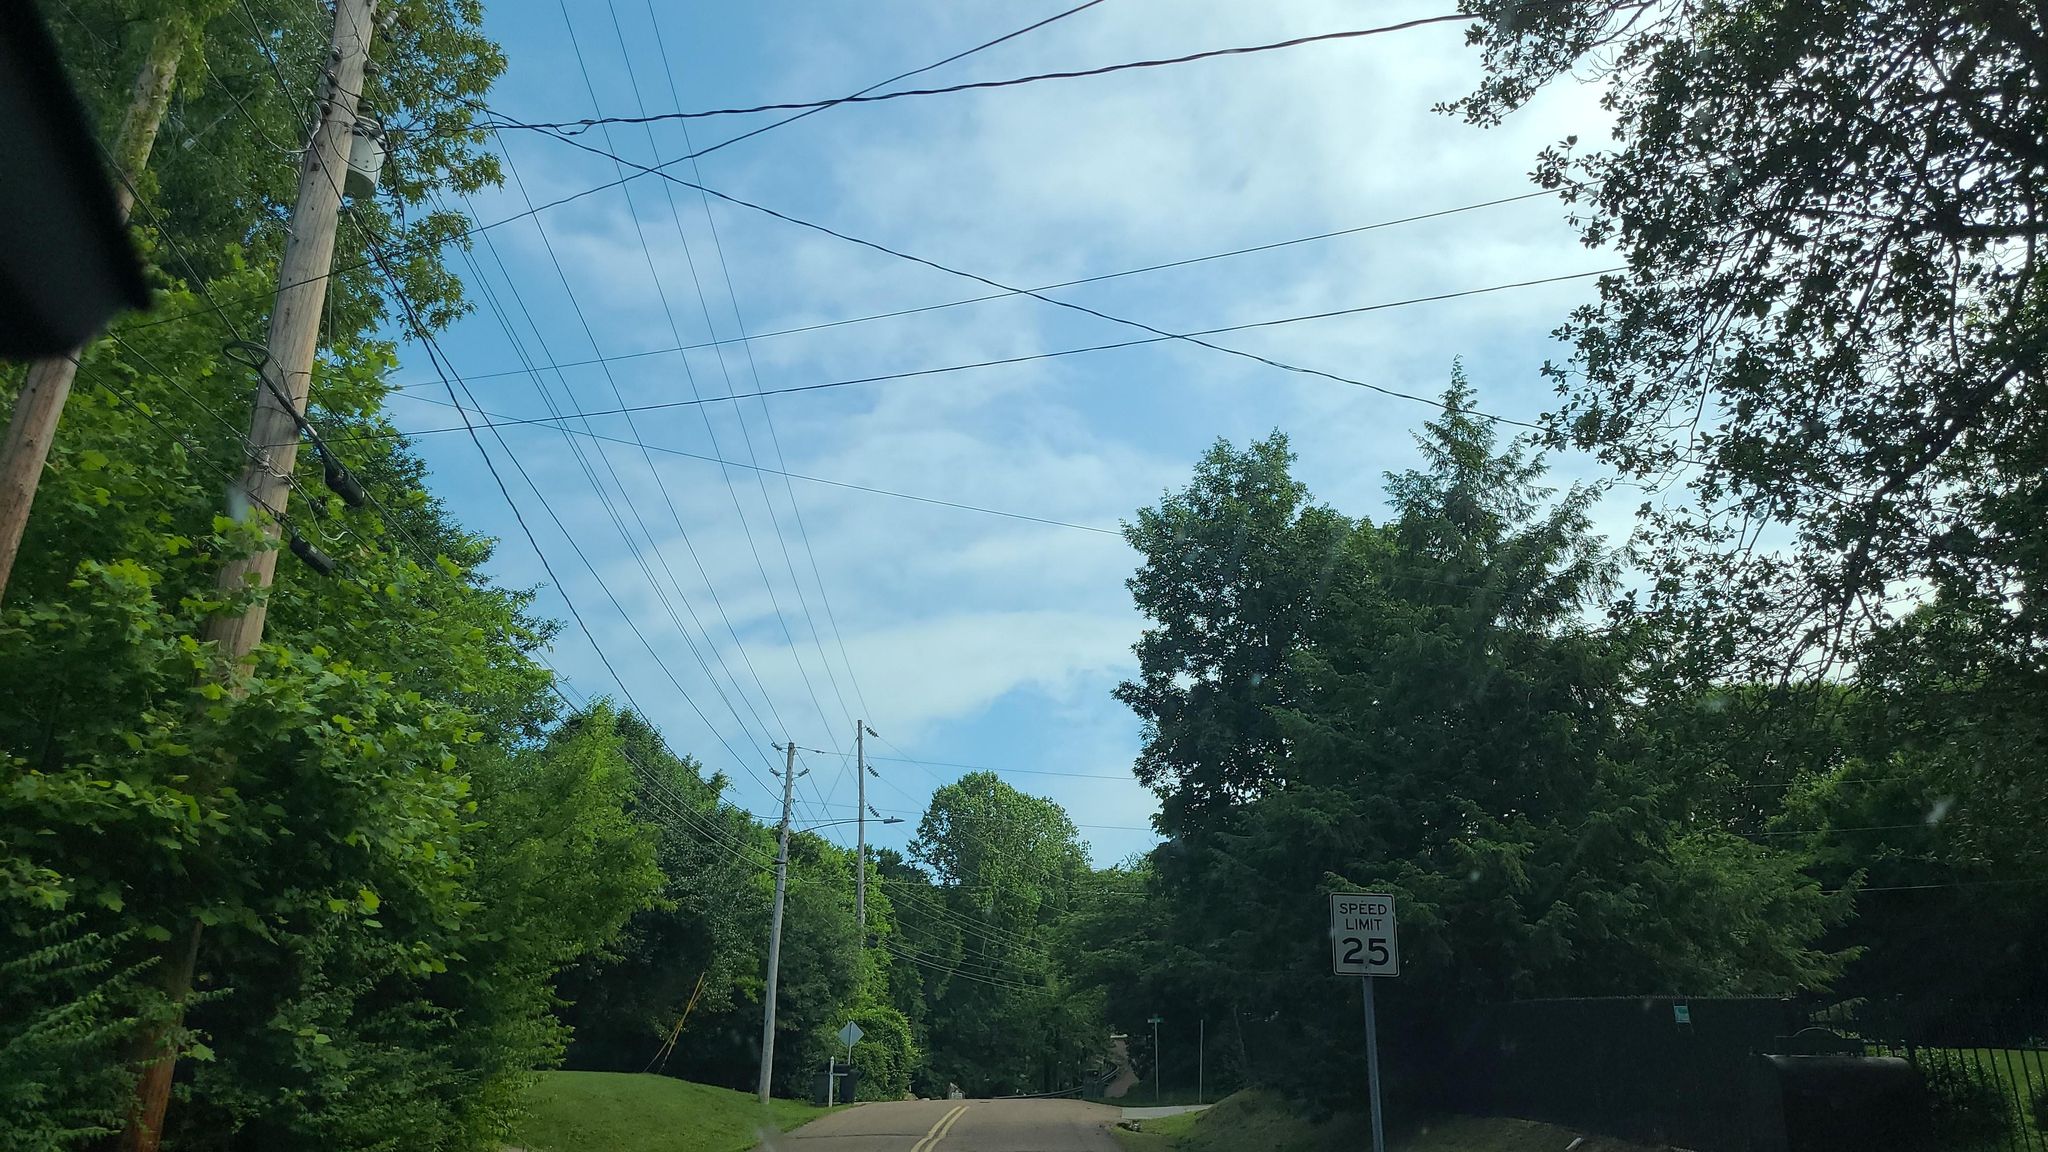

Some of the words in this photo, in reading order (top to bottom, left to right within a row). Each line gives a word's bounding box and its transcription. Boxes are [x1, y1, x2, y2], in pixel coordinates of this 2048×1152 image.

[1339, 903, 1387, 915] SPEED
[1345, 918, 1382, 931] LIMIT
[1342, 937, 1389, 966] 25
